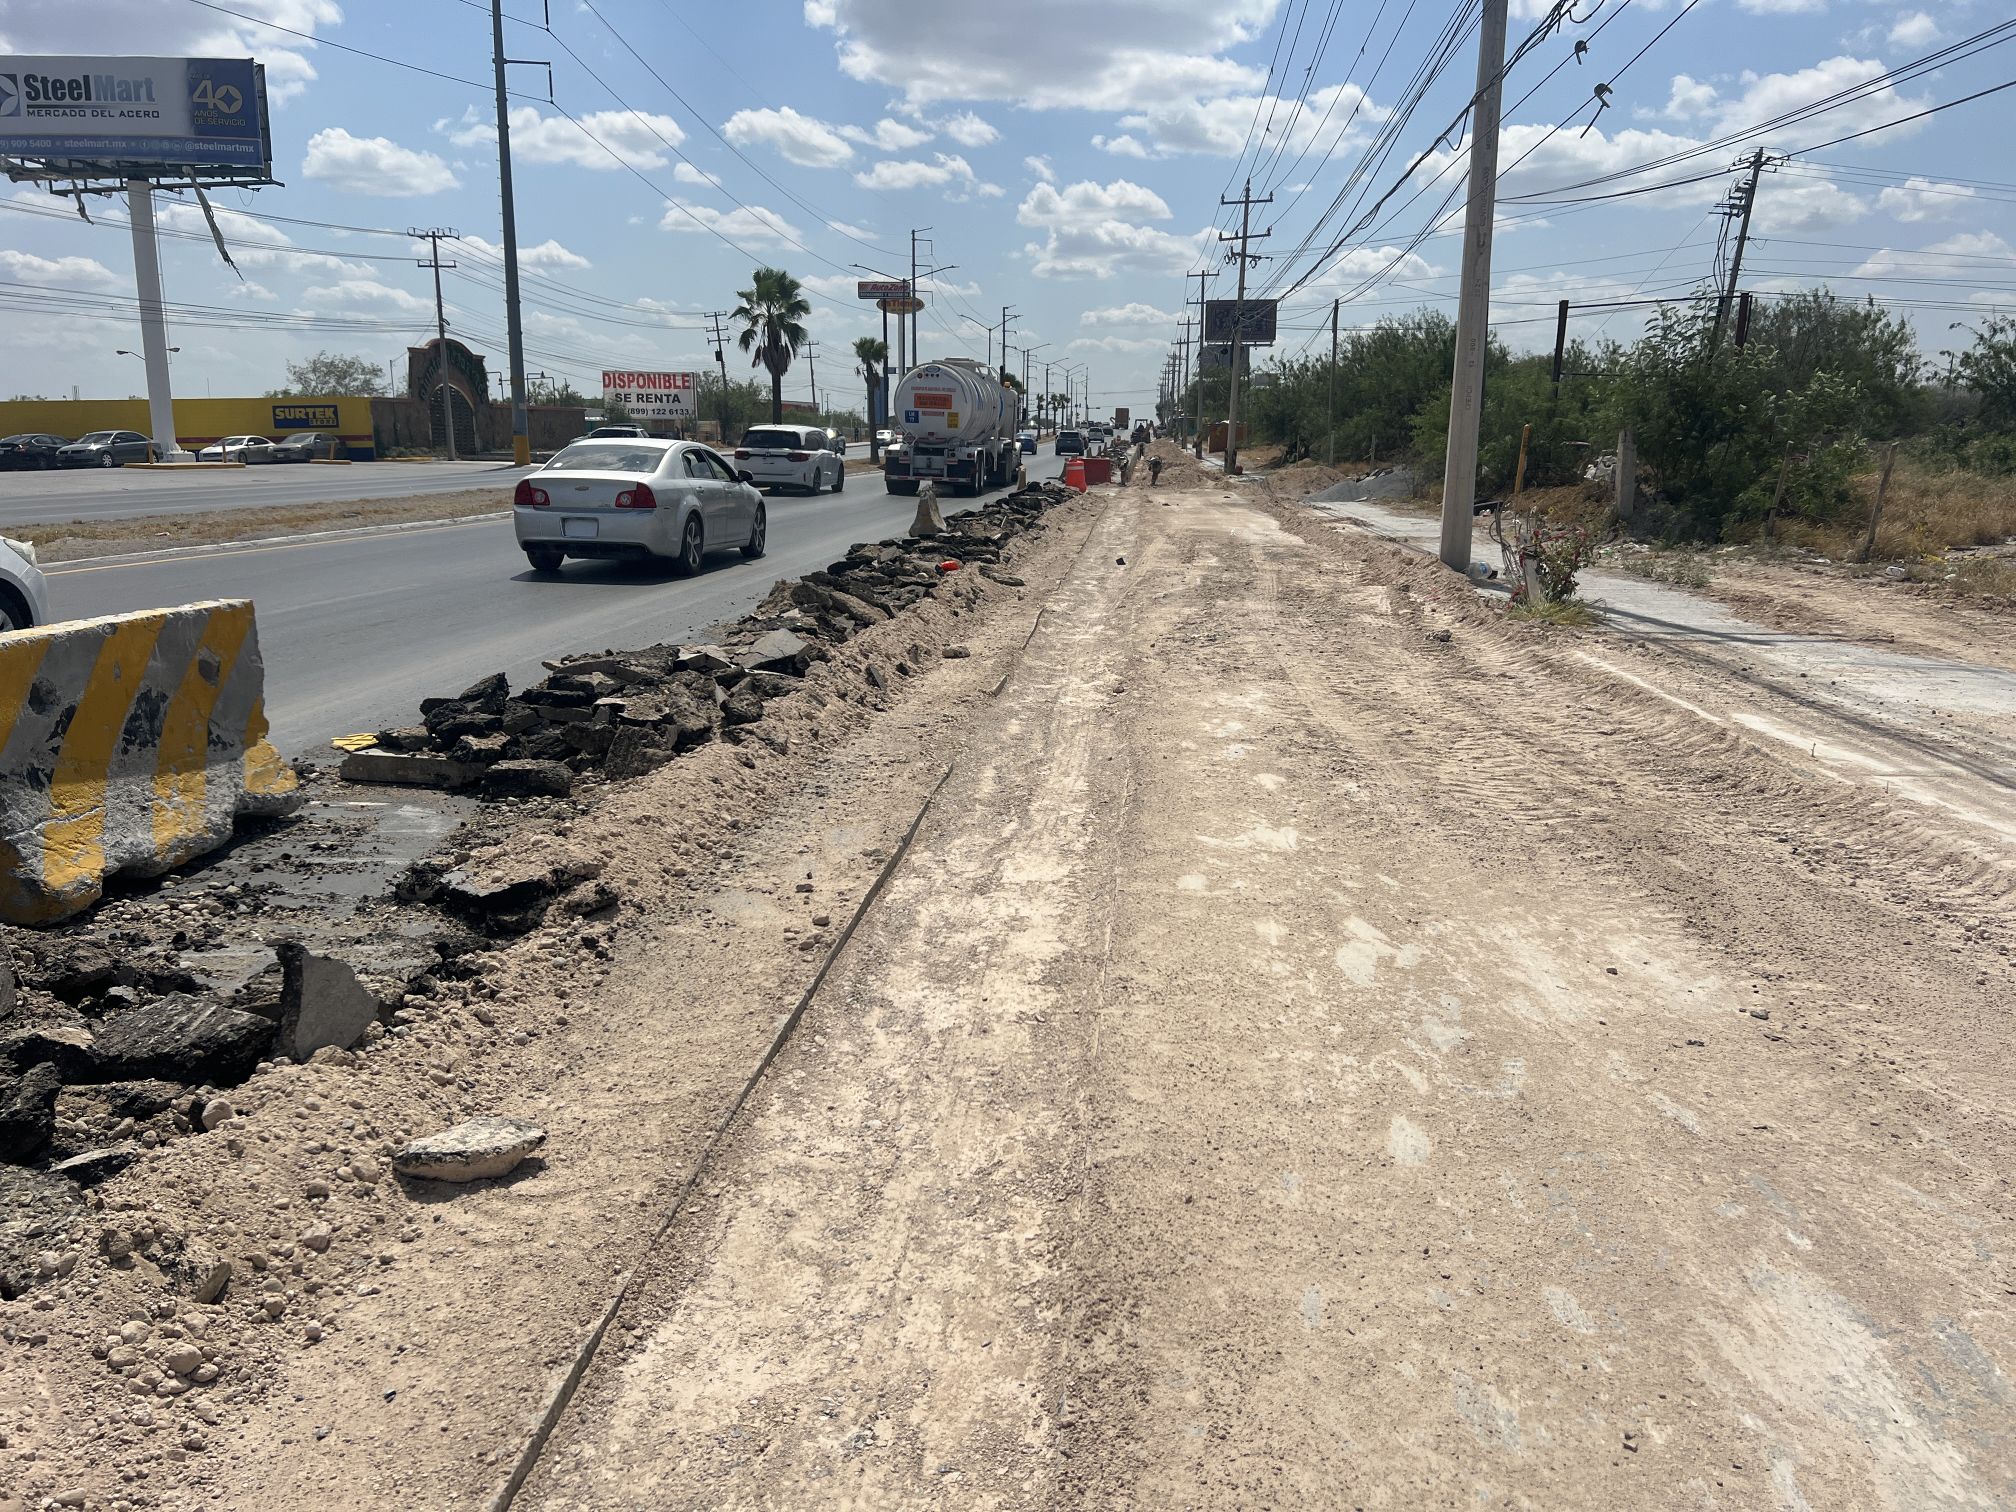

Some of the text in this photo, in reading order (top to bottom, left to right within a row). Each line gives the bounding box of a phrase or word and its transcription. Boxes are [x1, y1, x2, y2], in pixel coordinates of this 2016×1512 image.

[24, 74, 156, 102] SteelMart
[27, 109, 160, 119] MERCADO DEL ACERO
[207, 118, 246, 127] SERVICIO
[29, 139, 52, 148] 5400
[64, 139, 127, 149] steelmart.mx
[185, 141, 255, 154] @steelmartmx
[602, 372, 691, 389] DISPONIBLE
[614, 393, 681, 404] SE RENTA
[275, 408, 334, 419] SURTEK
[627, 408, 690, 417] (899) 122 6133
